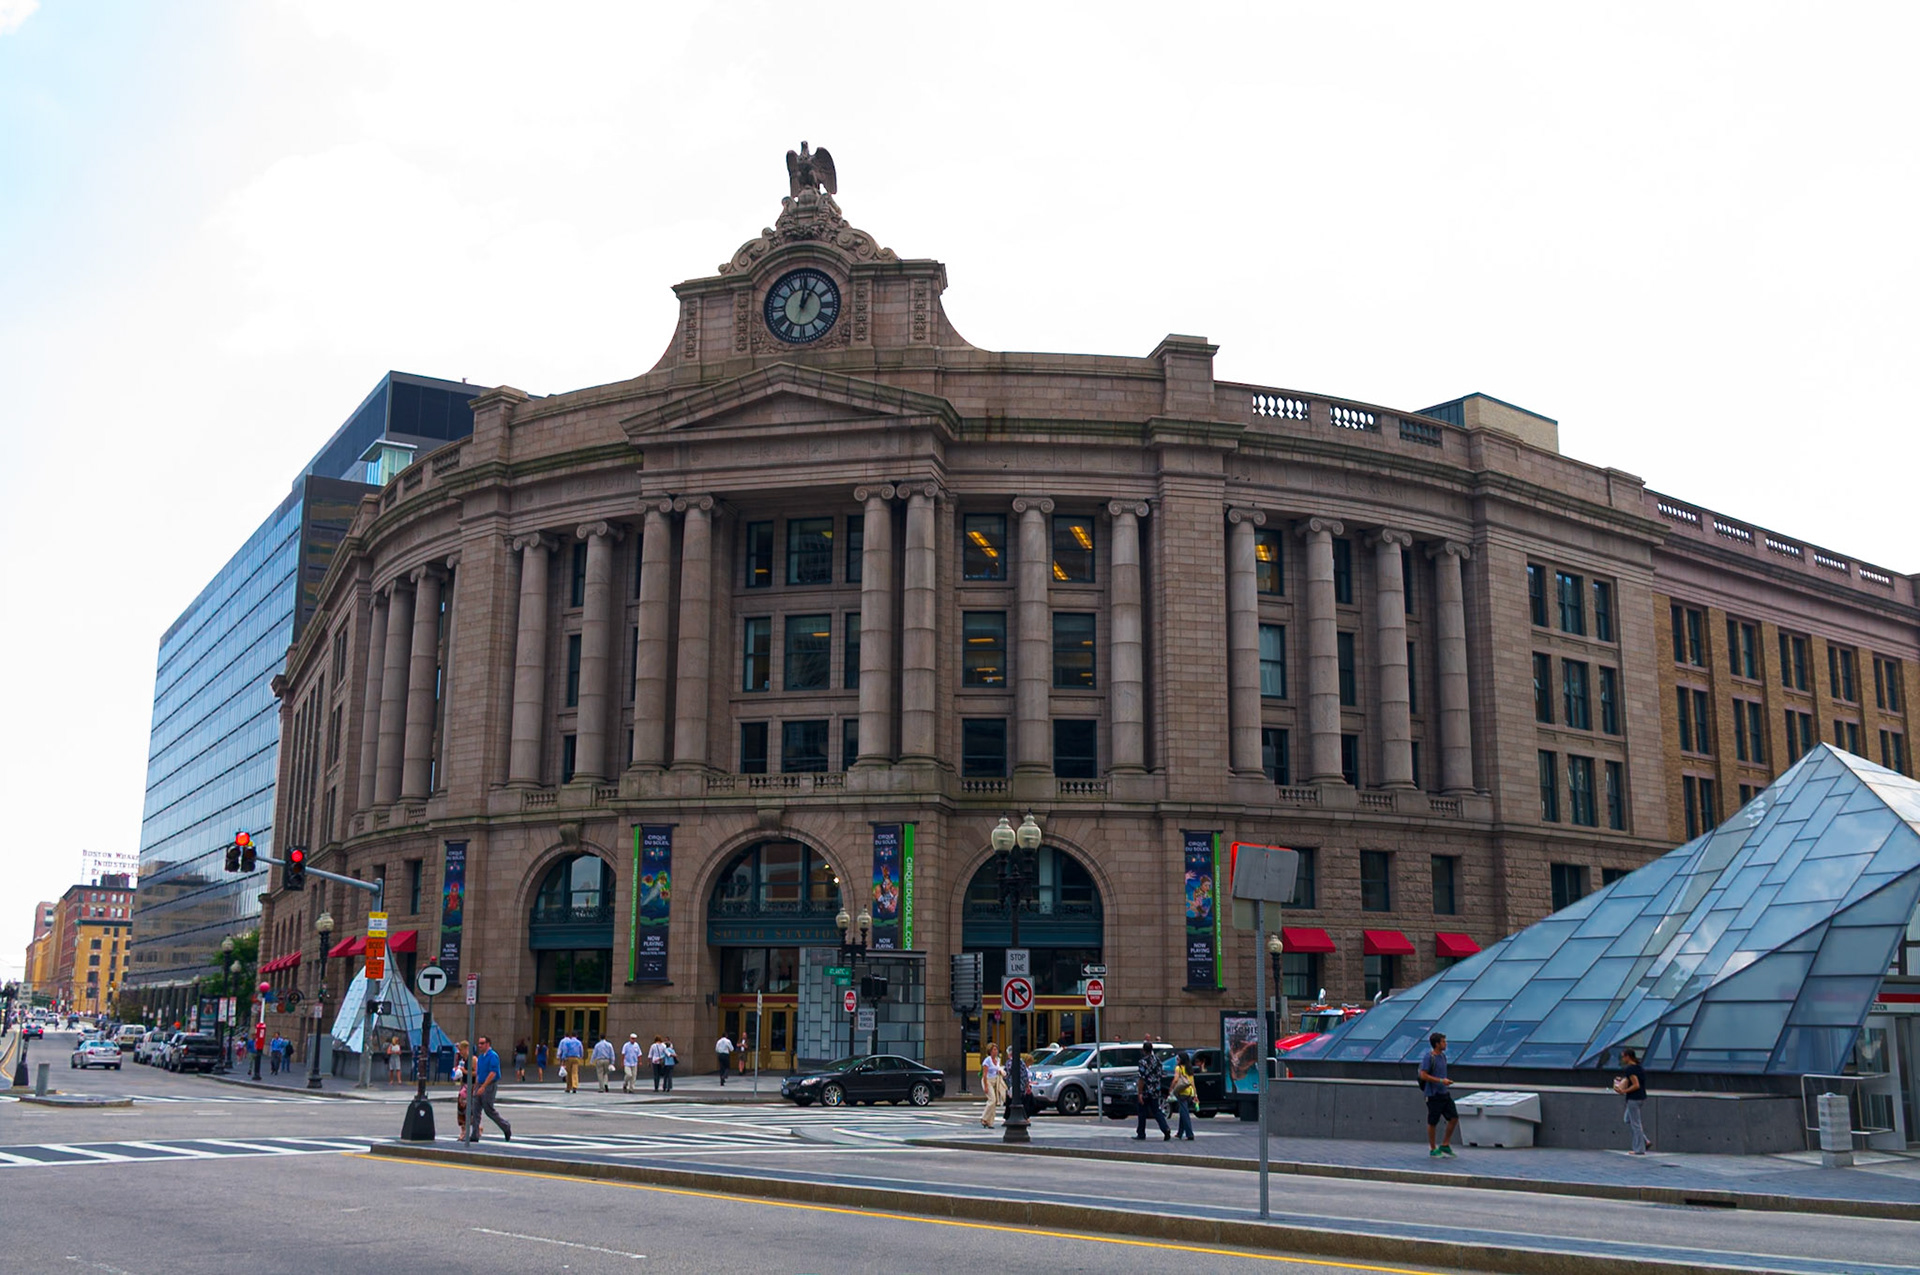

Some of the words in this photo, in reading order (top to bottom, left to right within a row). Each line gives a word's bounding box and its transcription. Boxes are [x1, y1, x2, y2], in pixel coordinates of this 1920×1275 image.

[714, 928, 765, 940] SOUTH
[1010, 953, 1026, 961] STOP
[1011, 963, 1025, 972] LINE
[423, 974, 443, 991] T
